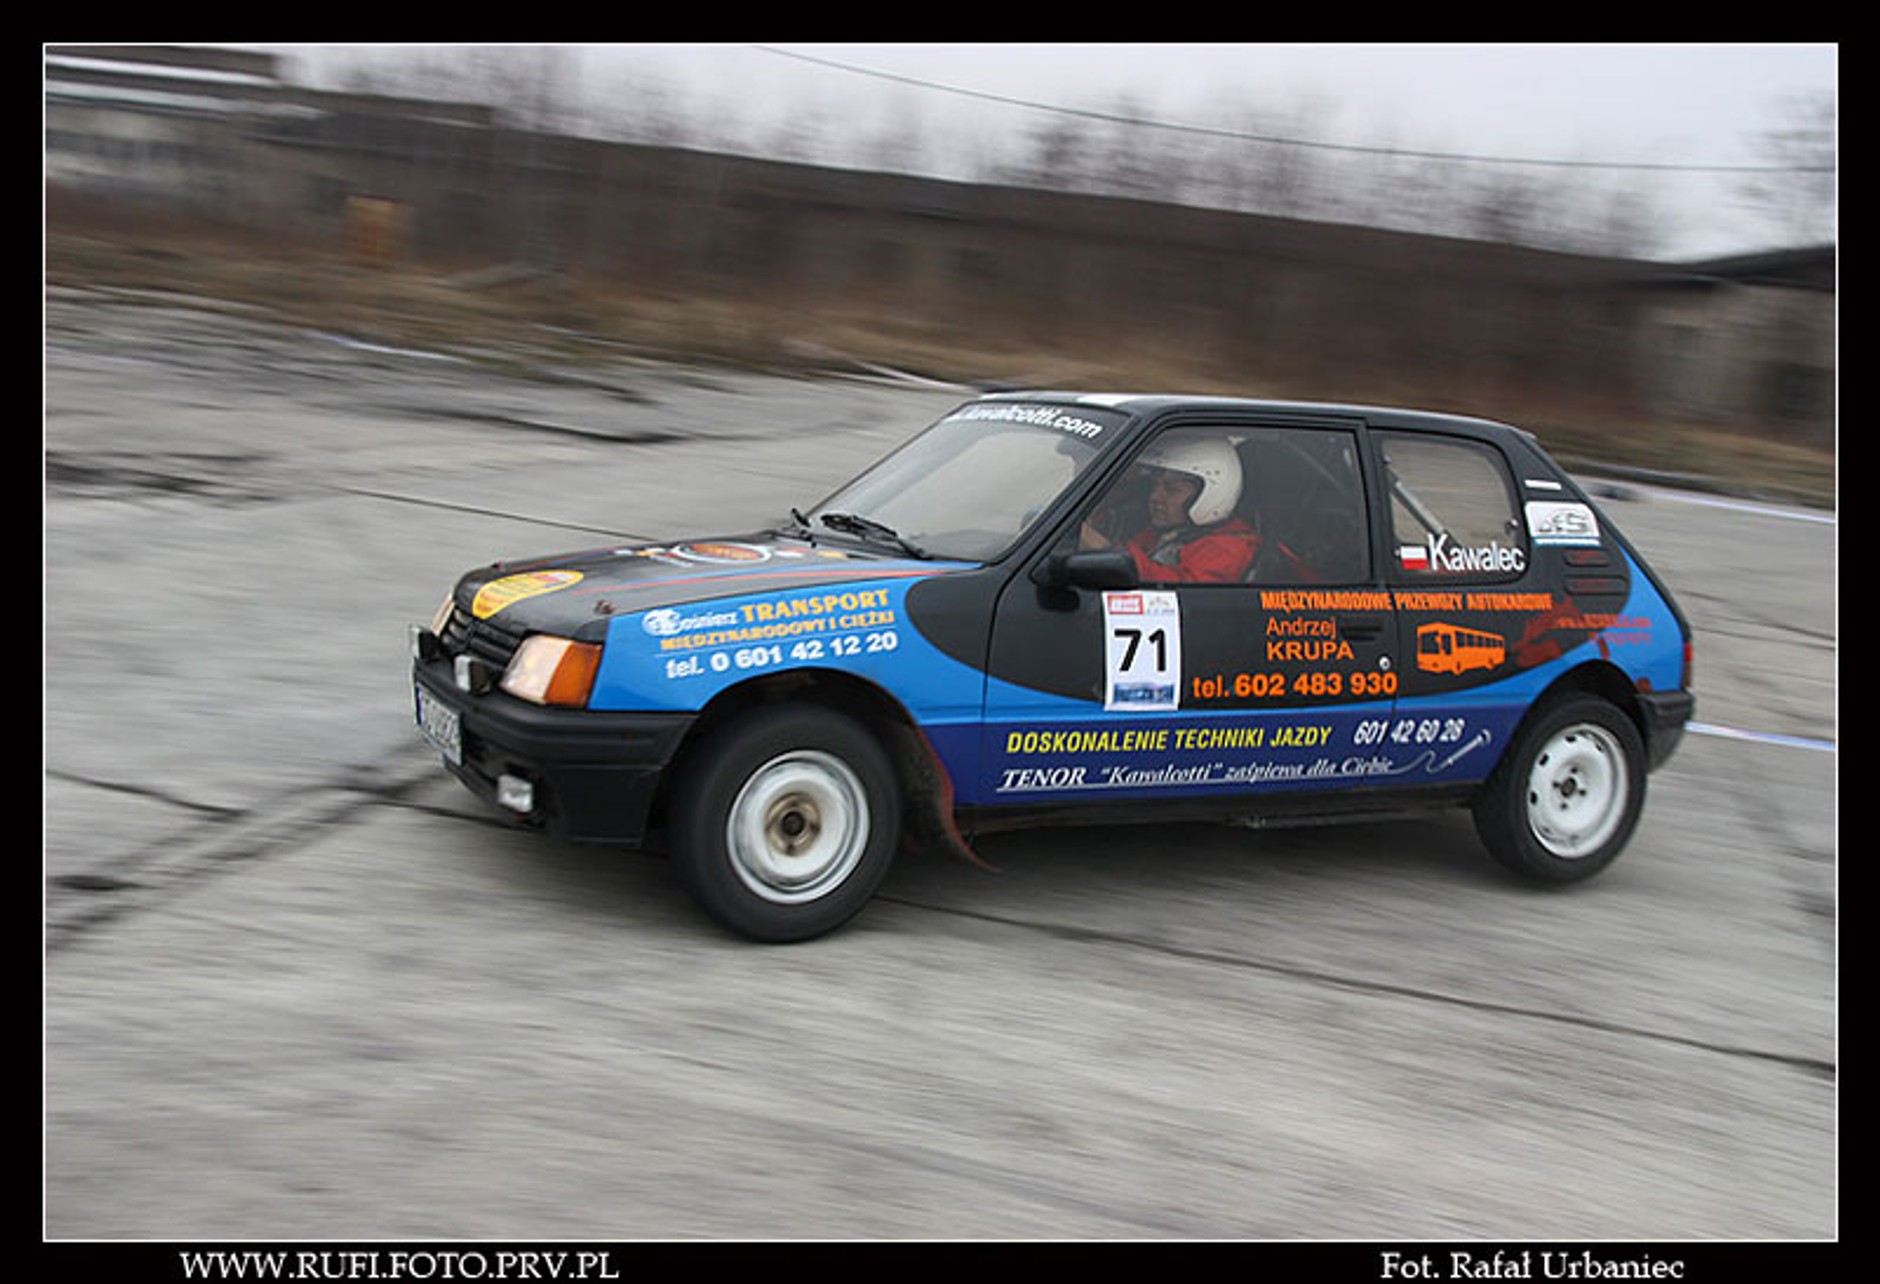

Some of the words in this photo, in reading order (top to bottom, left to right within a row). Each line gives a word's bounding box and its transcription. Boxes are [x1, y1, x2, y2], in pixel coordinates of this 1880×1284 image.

[1427, 533, 1526, 572] Kawalec
[740, 589, 889, 623] TRANSPORT
[1260, 591, 1393, 615] MIĘDZYNARODOWE
[1266, 616, 1338, 640] Andrzej
[665, 656, 705, 679] tel.
[710, 652, 730, 672] 0
[735, 646, 783, 668] 601
[790, 640, 823, 660] 42
[829, 634, 862, 655] 12
[866, 631, 898, 652] 20
[1114, 628, 1167, 672] 71
[1267, 640, 1356, 661] KRUPA
[1193, 675, 1230, 698] tel.
[1234, 673, 1286, 697] 602
[1293, 672, 1343, 696] 483
[1350, 671, 1399, 695] 930
[1006, 730, 1170, 754] DOSKONALENIE
[1174, 727, 1265, 749] TECHNIKI
[1269, 726, 1333, 748] JAZDY
[1353, 720, 1389, 745] 601
[1391, 719, 1415, 743] 42
[1416, 718, 1441, 743] 60
[1002, 766, 1088, 789] TENOR
[1307, 758, 1338, 776] dla
